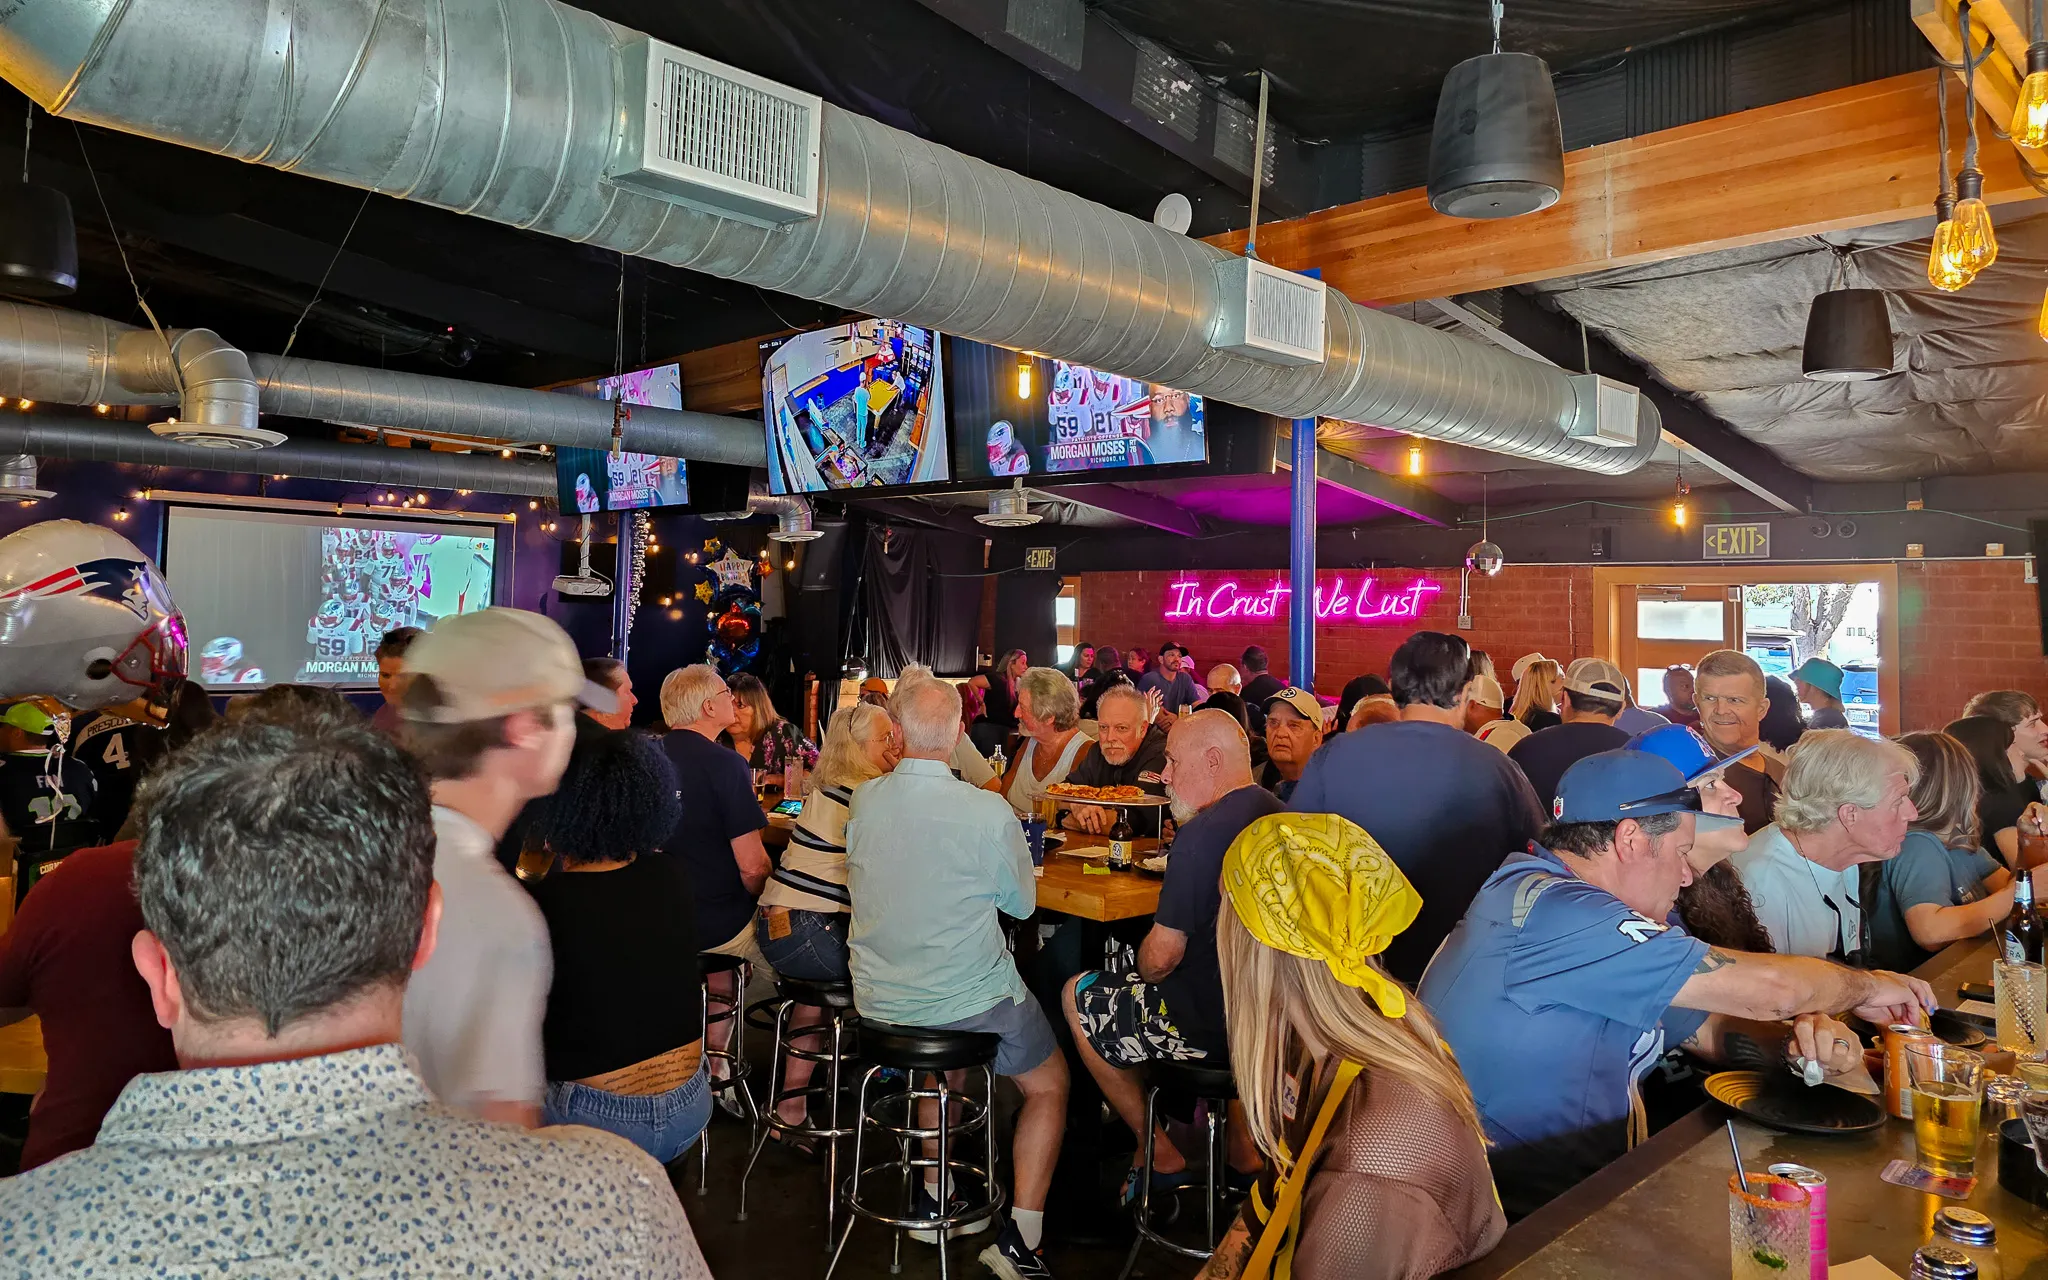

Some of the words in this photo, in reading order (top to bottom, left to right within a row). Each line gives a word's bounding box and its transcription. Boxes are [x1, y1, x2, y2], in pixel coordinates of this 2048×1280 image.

[1057, 416, 1079, 438] 59
[1095, 411, 1113, 433] 21
[1050, 442, 1091, 460] MORGAN
[1092, 440, 1126, 456] MOSES
[612, 471, 624, 487] 59
[632, 489, 648, 500] MOSES
[1717, 526, 1758, 554] EXIT
[355, 550, 371, 560] 24
[1031, 549, 1051, 568] EXIT
[719, 561, 746, 571] HAPPY
[1164, 581, 1203, 618] In
[1206, 580, 1293, 618] Crust
[1355, 577, 1441, 618] Lust
[317, 637, 346, 656] 59
[305, 661, 359, 673] MORGAN
[102, 733, 131, 770] 4
